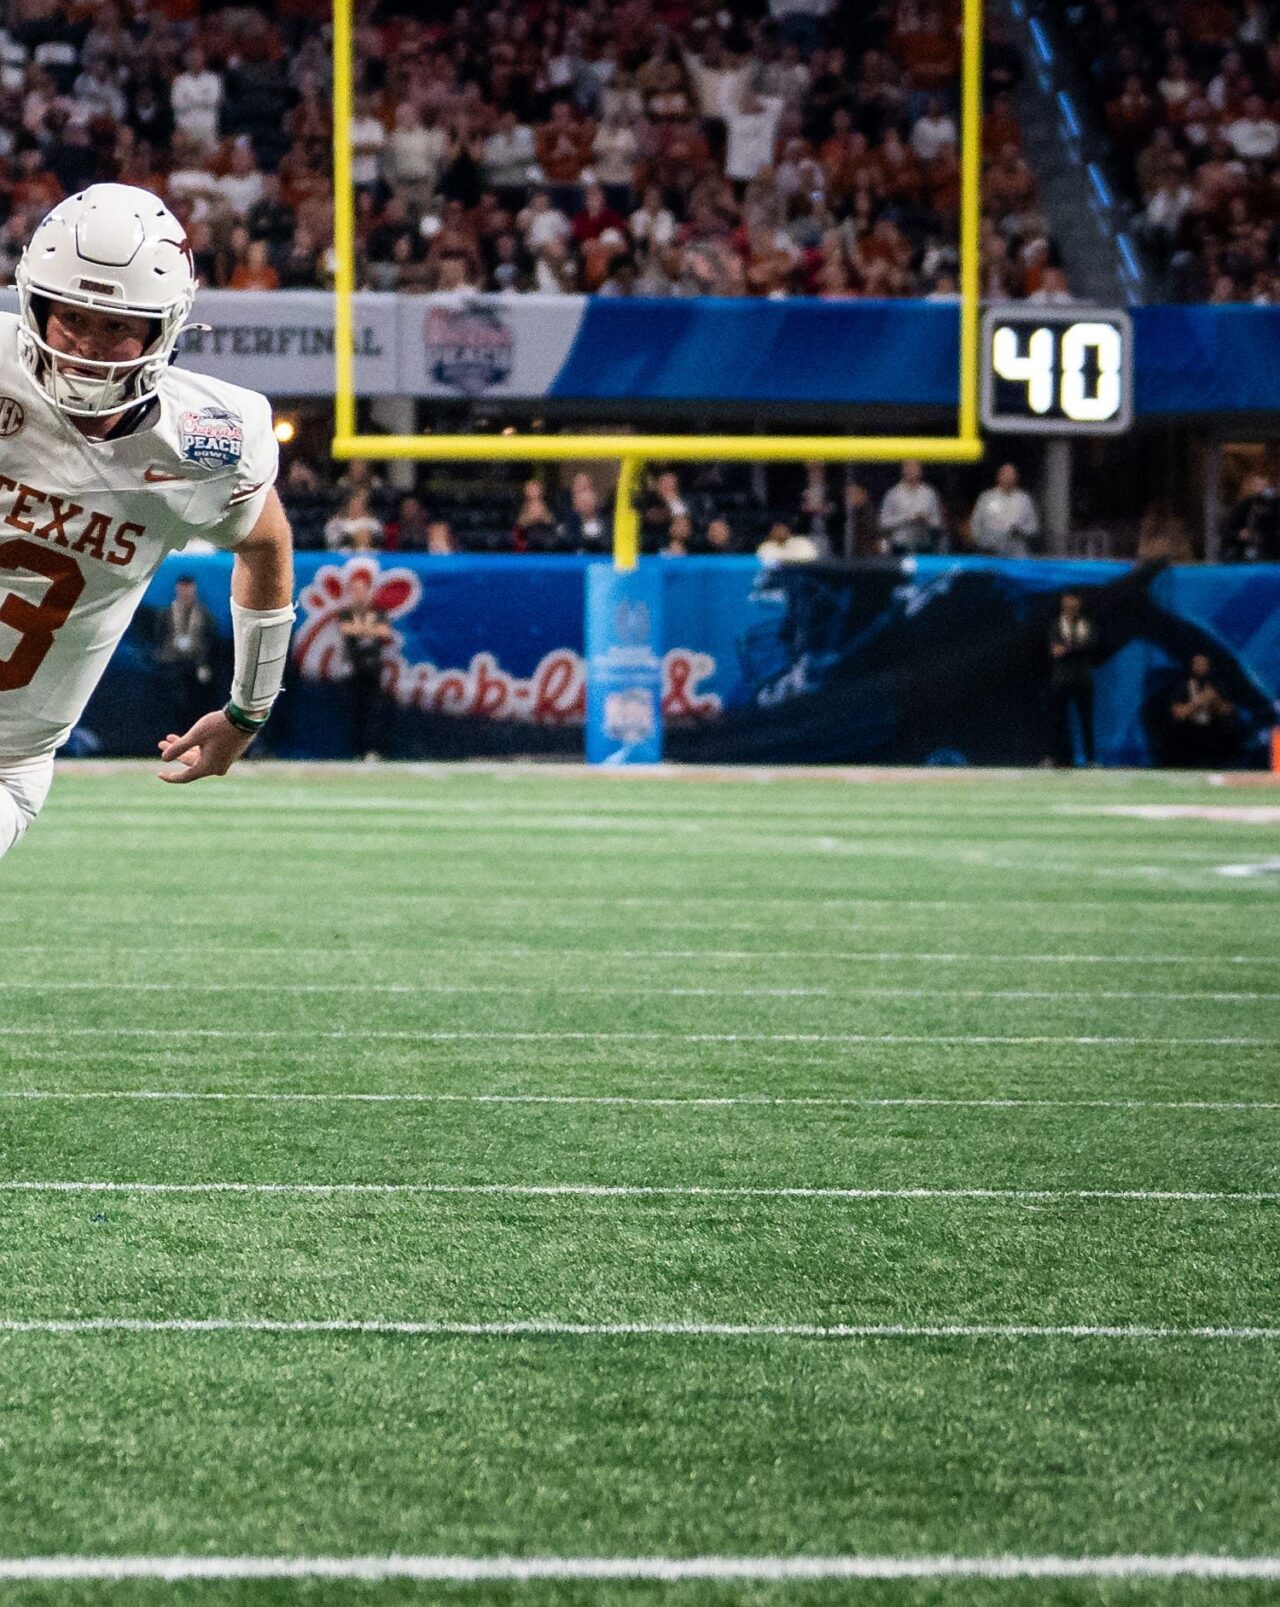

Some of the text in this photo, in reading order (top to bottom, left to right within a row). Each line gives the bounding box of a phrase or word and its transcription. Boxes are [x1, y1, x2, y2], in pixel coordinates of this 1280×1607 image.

[993, 323, 1121, 421] 40
[183, 435, 241, 456] PEACH
[194, 450, 229, 460] BOWL
